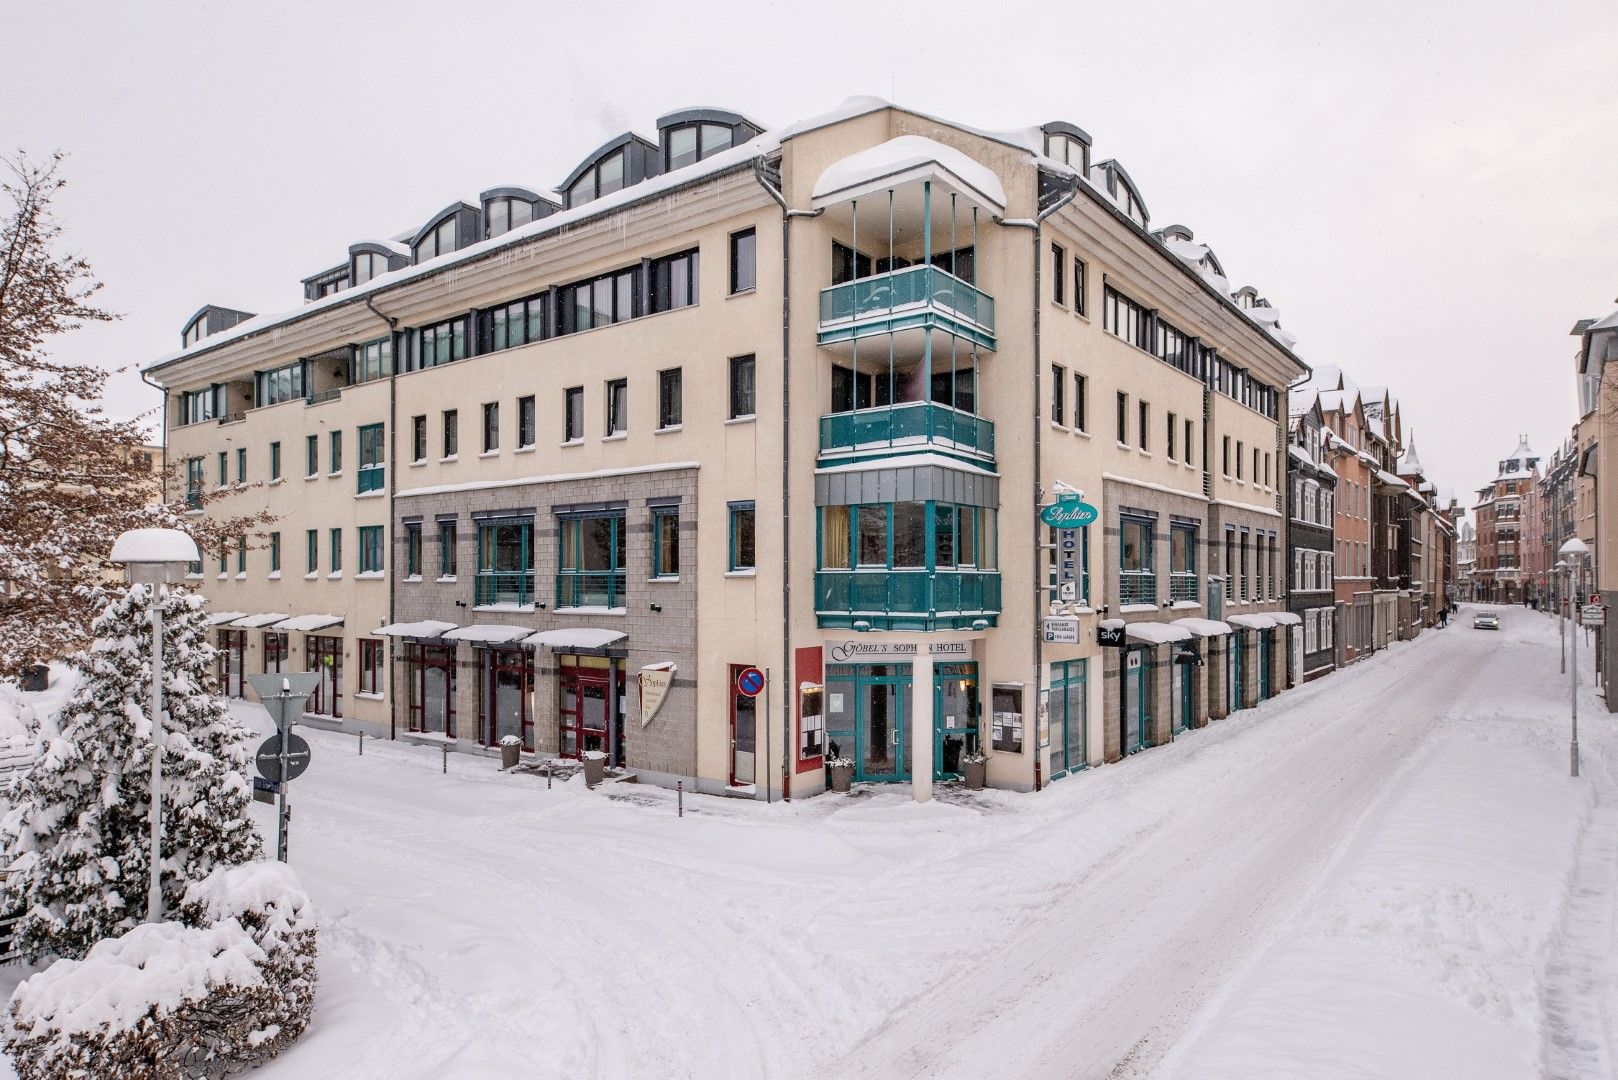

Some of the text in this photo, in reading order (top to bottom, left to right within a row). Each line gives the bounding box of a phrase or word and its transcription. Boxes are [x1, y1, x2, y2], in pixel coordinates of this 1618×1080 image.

[1063, 530, 1075, 579] HOTEL
[1101, 628, 1121, 642] sky
[893, 643, 933, 652] SOPHN
[936, 643, 967, 652] HOTEL
